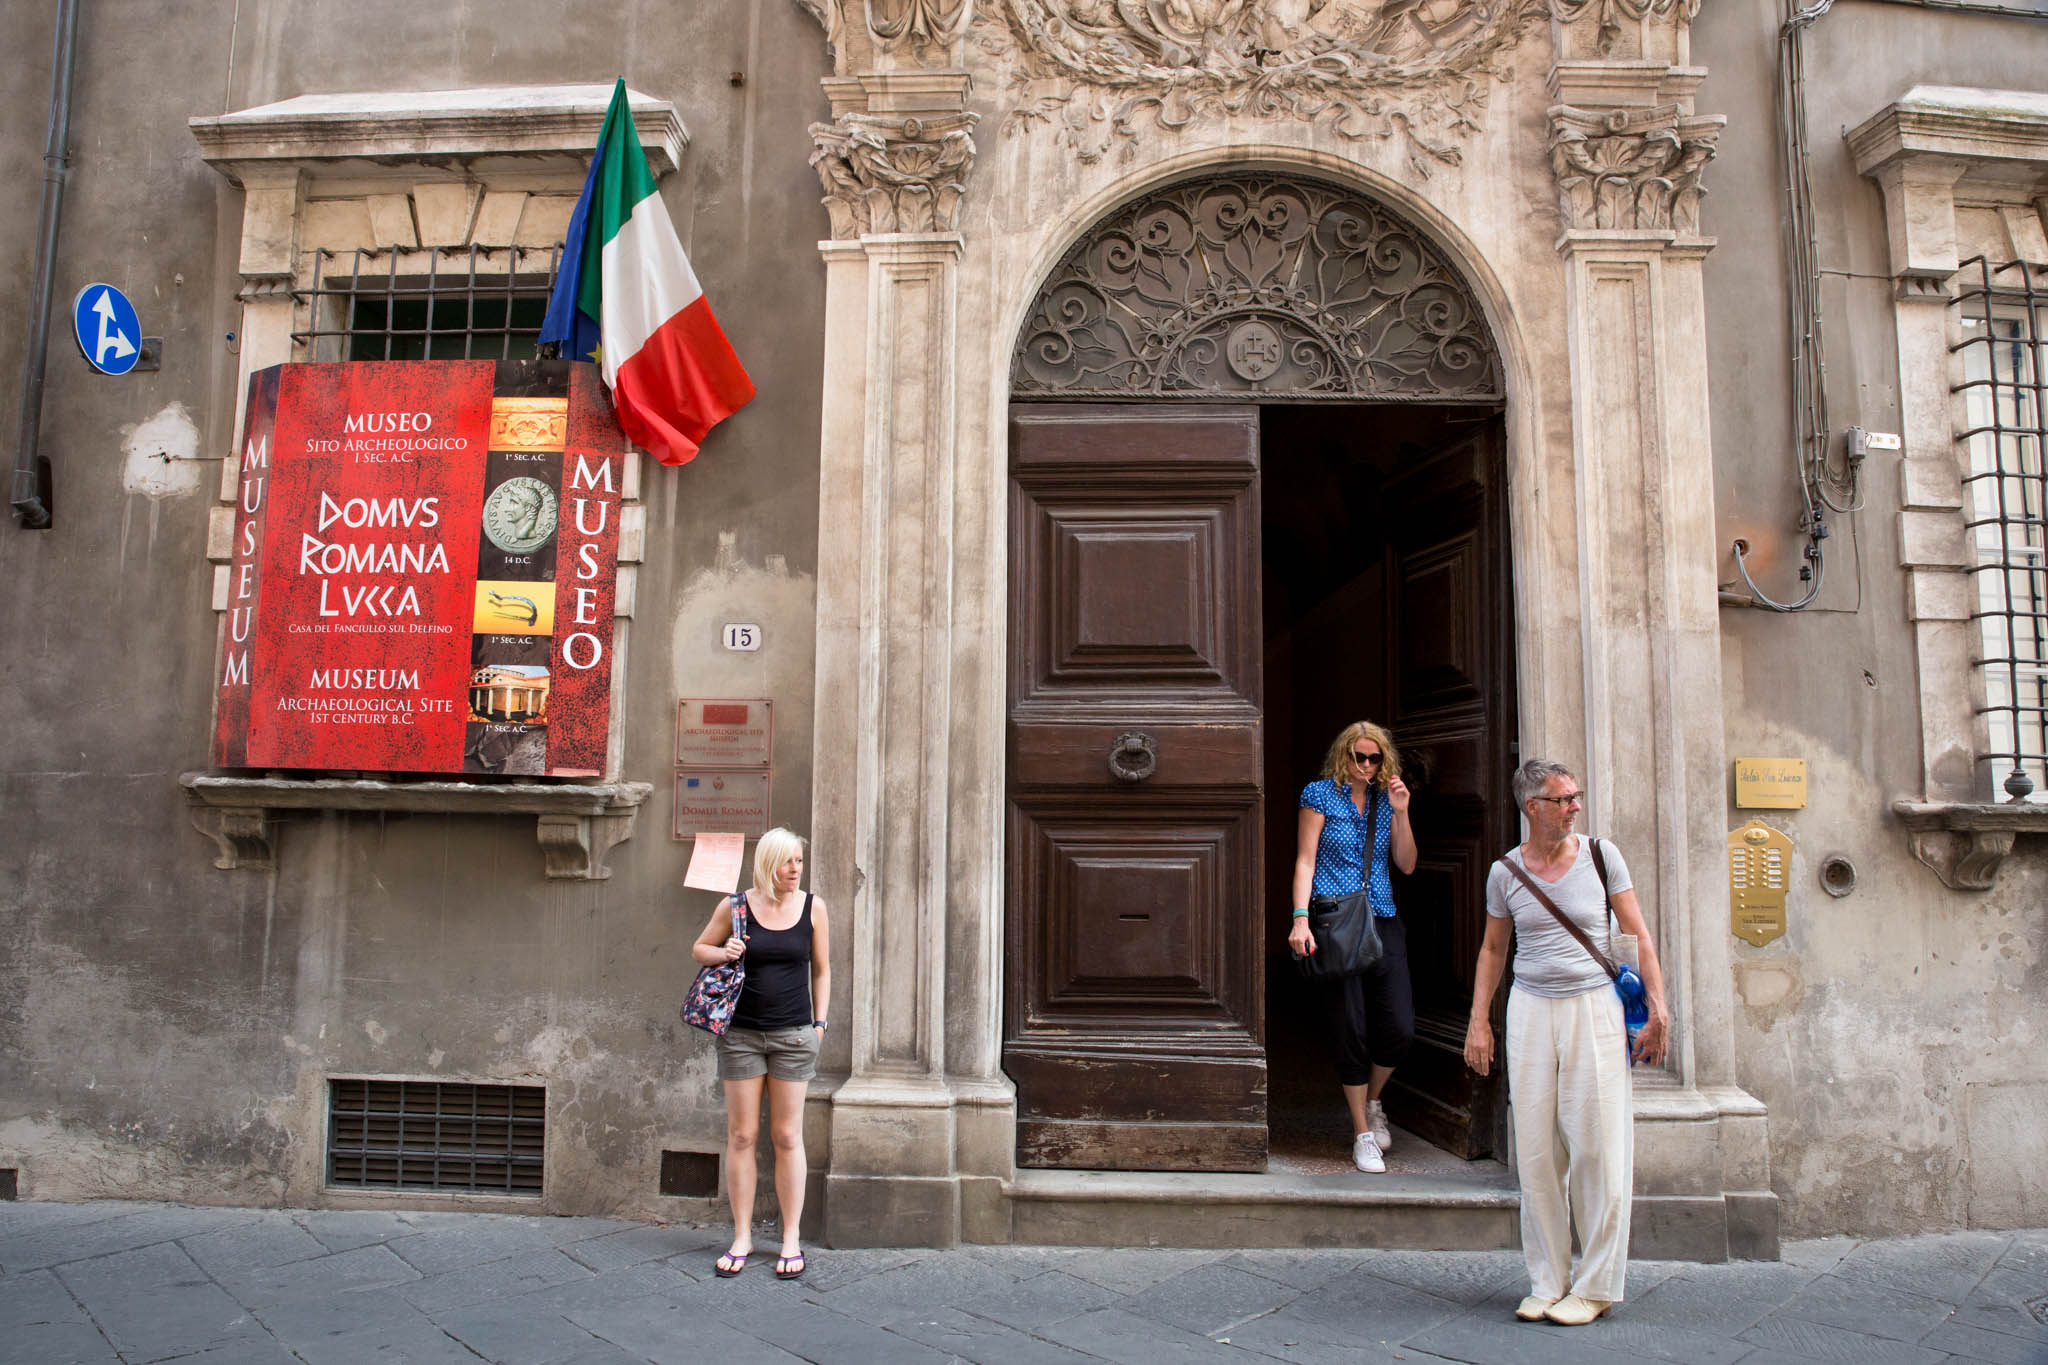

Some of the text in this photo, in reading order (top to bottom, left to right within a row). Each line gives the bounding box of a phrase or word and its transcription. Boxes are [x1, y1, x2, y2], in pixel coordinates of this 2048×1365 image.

[343, 412, 432, 433] MUSEO
[306, 437, 468, 453] SITO ARCHEOLOGICO
[363, 452, 387, 463] SEC.
[390, 451, 414, 463] A.C.
[319, 491, 439, 533] DOMVS
[223, 434, 268, 687] MUSEUM
[300, 532, 450, 575] ROMANA
[505, 556, 514, 564] 14
[562, 453, 617, 670] MUSEO
[288, 623, 453, 633] CASA DEL FANCIULLO SUL DELFINO
[731, 628, 752, 647] 15
[309, 668, 421, 690] MUSEUM
[277, 696, 453, 713] ARCHAEOLOGICAL SITE
[332, 713, 389, 724] CENTURY
[391, 713, 415, 725] B.C.
